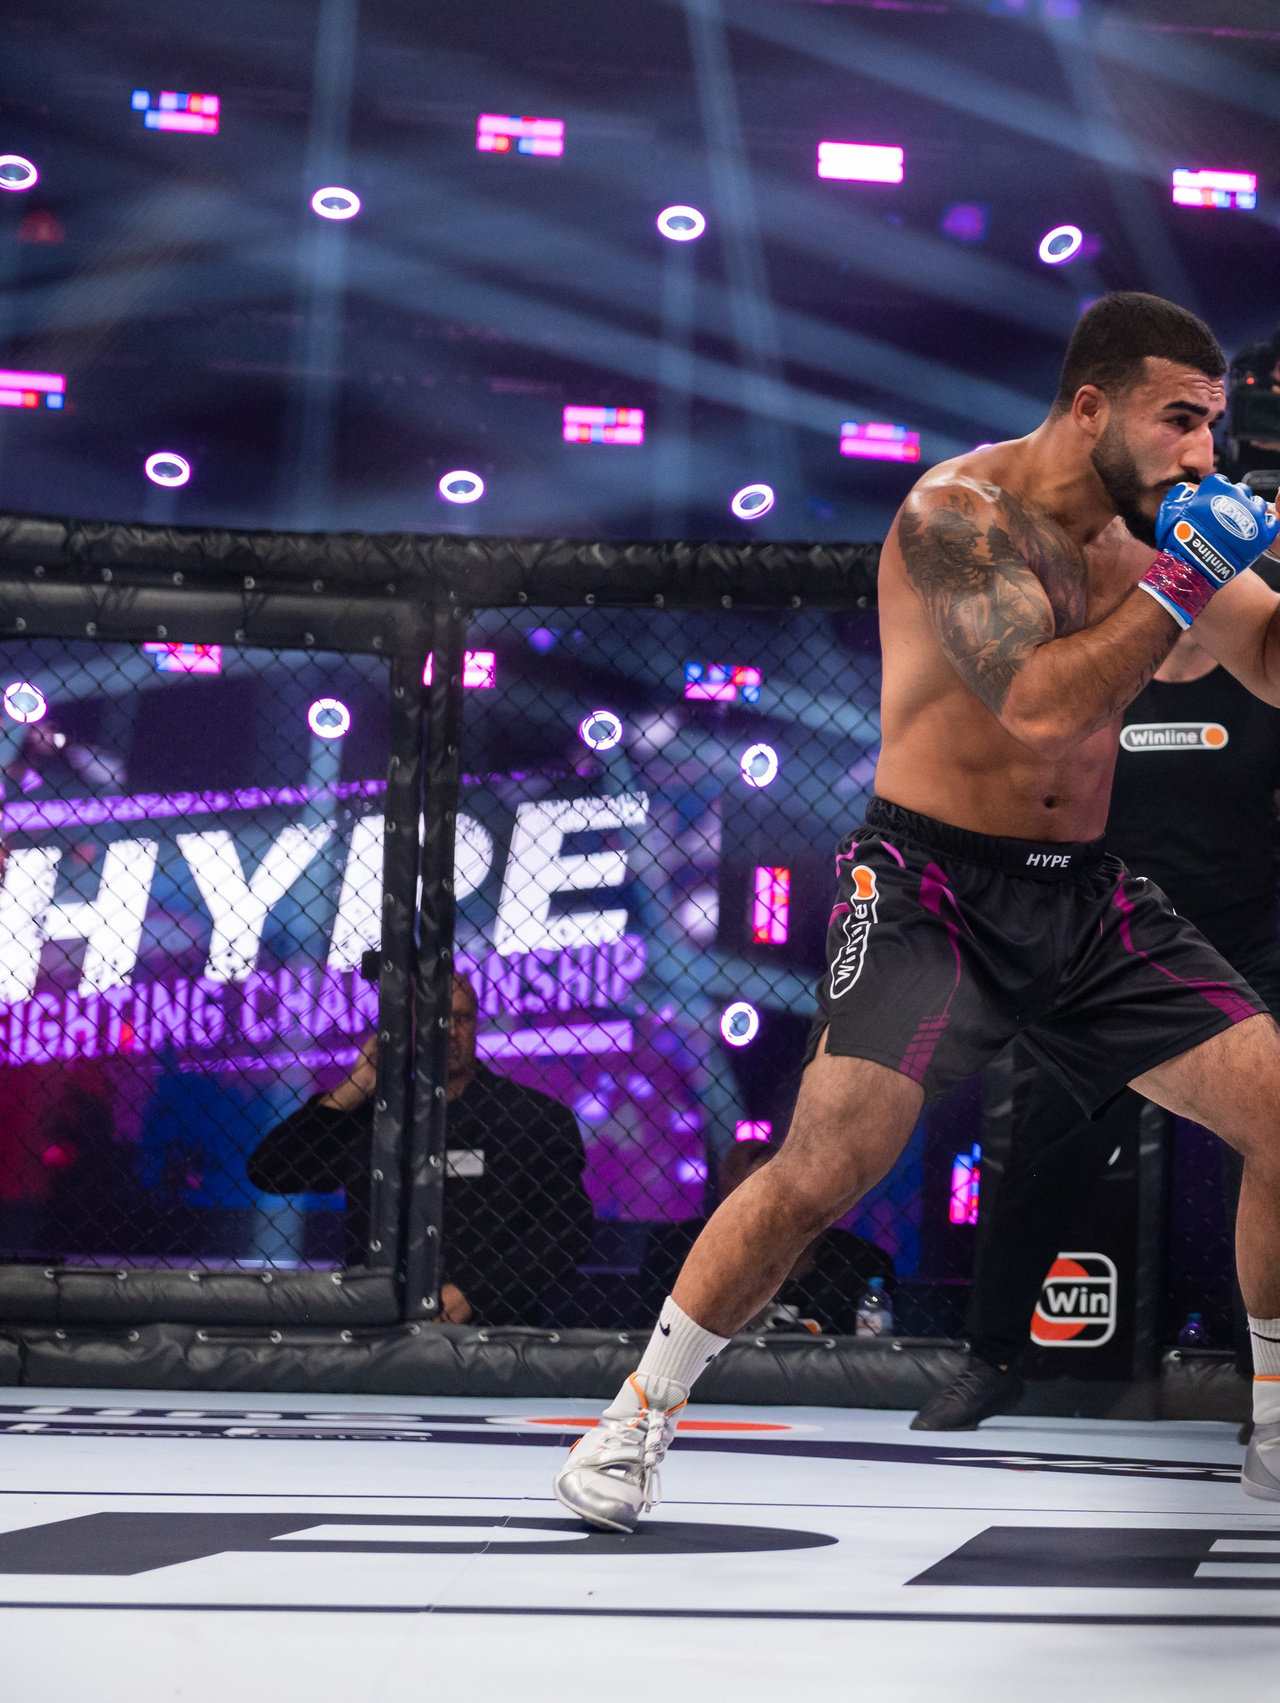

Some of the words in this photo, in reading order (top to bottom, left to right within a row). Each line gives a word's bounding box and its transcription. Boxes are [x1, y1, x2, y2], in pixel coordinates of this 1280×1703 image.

[1192, 538, 1231, 579] Winline
[1130, 729, 1198, 745] Winline
[1025, 853, 1071, 868] HYPE
[0, 976, 226, 1066] IGHTING
[242, 933, 647, 1044] CHAMONSHIP
[1045, 1286, 1109, 1314] Win
